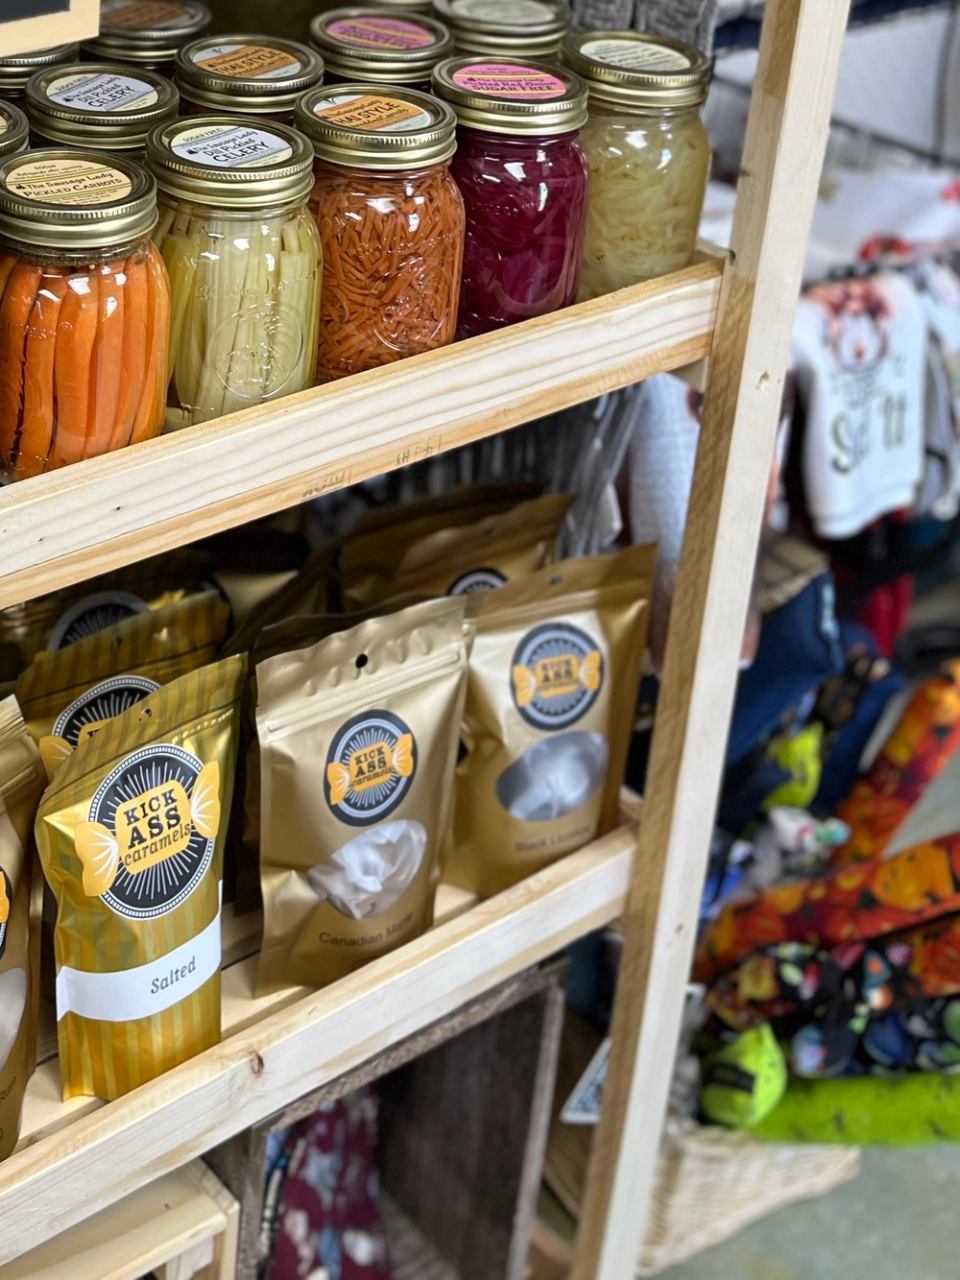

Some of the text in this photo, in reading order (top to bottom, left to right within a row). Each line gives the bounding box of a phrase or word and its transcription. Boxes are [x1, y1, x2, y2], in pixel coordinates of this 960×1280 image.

[88, 86, 136, 107] CELERY
[358, 102, 401, 120] STYLE
[213, 141, 270, 162] CELERY
[45, 178, 86, 188] Sausage
[86, 171, 115, 181] Lady
[354, 745, 385, 766] KICK
[356, 756, 387, 778] ASS
[123, 788, 178, 826] KICK
[127, 806, 181, 850] ASS
[123, 821, 191, 866] caramels
[319, 930, 384, 946] Canadian
[150, 956, 197, 995] Salted
